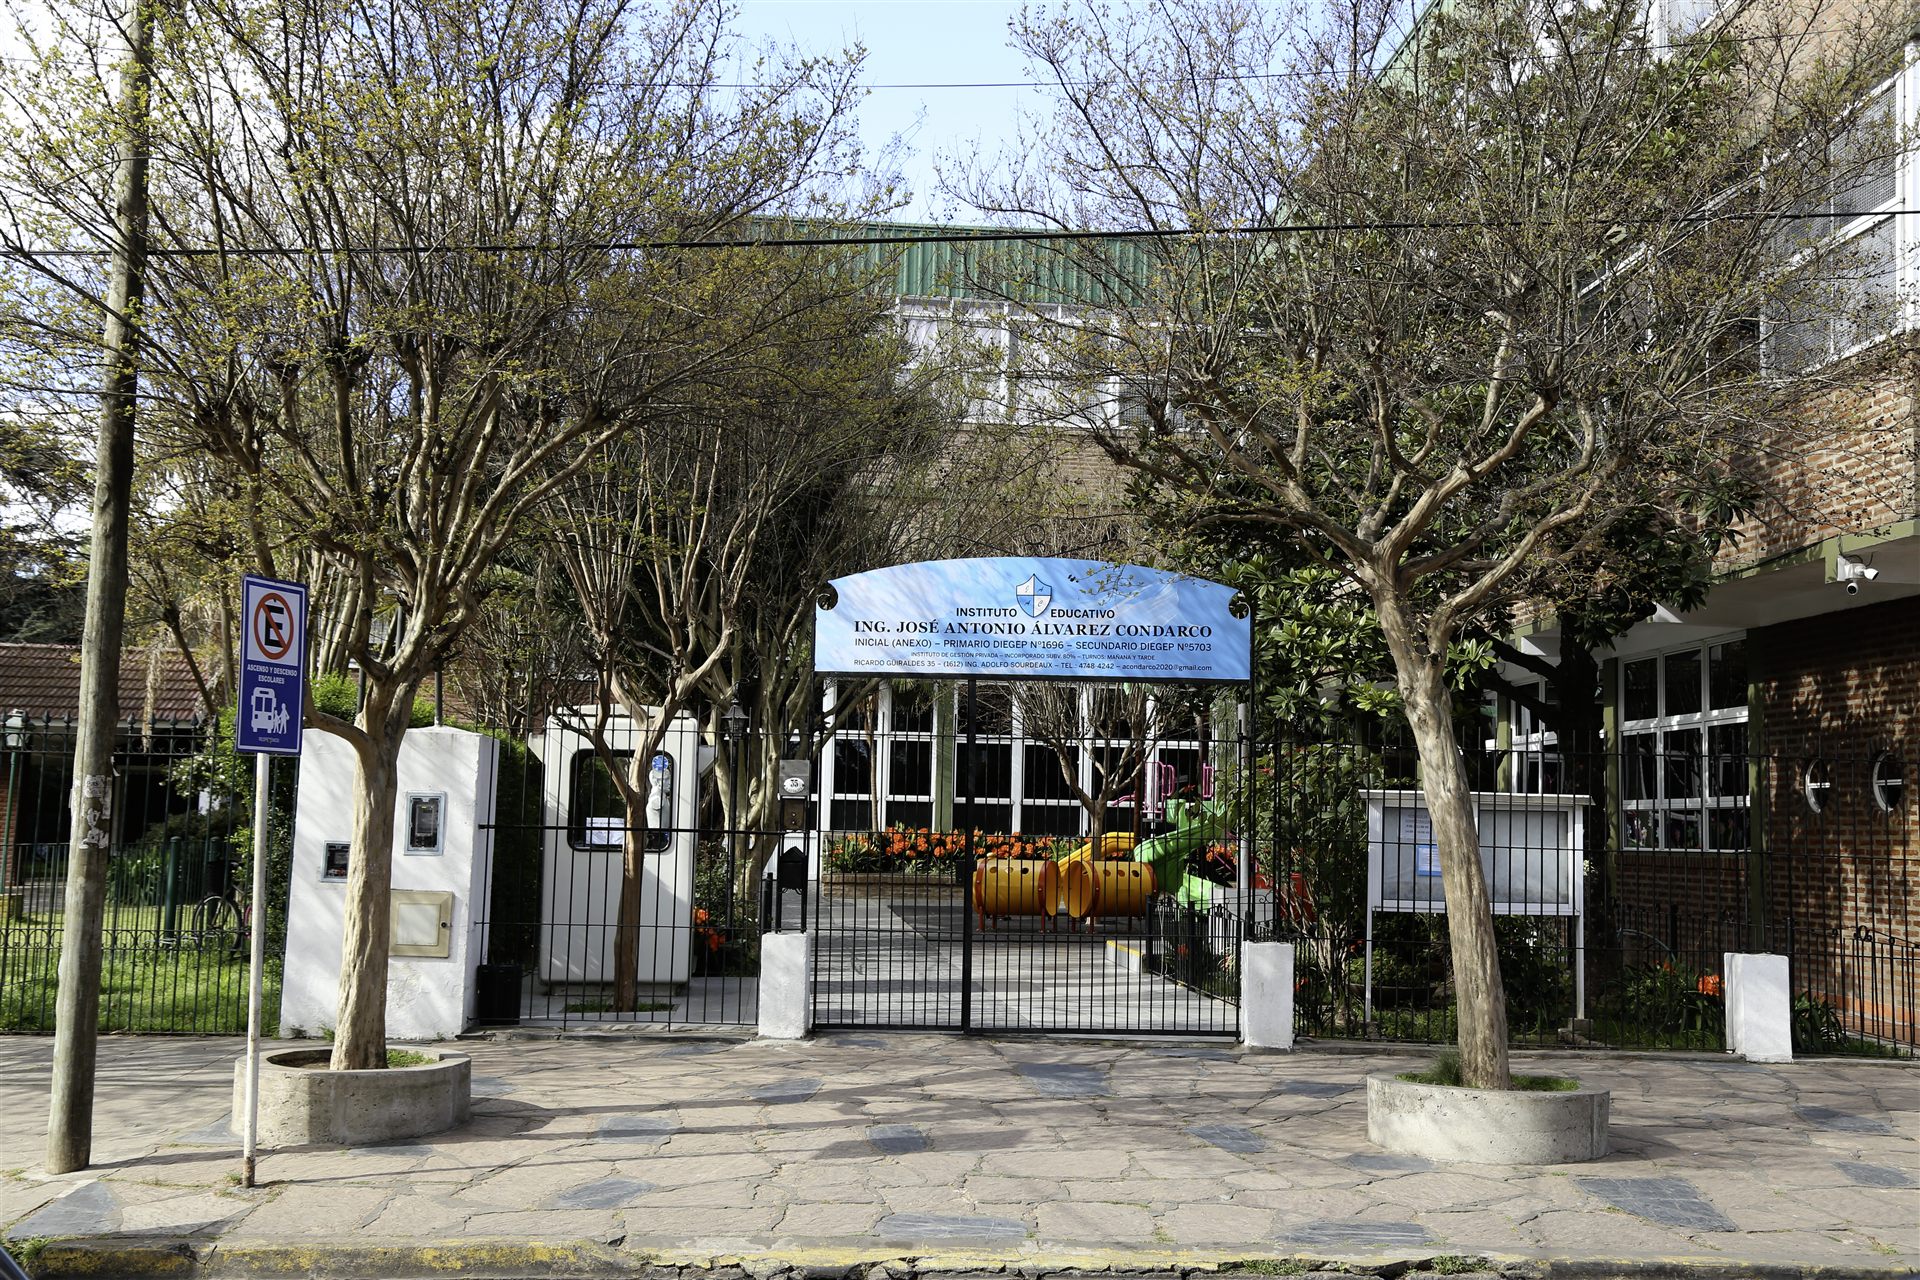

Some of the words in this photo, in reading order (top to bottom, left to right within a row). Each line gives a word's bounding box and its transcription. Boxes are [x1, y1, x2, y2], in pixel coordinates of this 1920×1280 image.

[956, 607, 1018, 618] INSTITUTO
[1050, 608, 1115, 619] EDUCATIVO
[264, 604, 285, 649] E
[854, 620, 891, 633] ING.
[896, 619, 939, 634] JOSÉ
[945, 622, 1026, 635] ANTONIO
[1031, 620, 1111, 637] ÁLVAREZ
[1115, 624, 1212, 638] CONDARCO
[855, 638, 889, 647] INICIAL
[891, 638, 932, 649] (ANEXO)
[943, 639, 990, 649] PRIMARIO
[993, 640, 1028, 649] DIEGEP
[1075, 641, 1137, 651] SECUNDARIO
[1140, 641, 1174, 651] DIEGEP
[1107, 653, 1132, 661] MAÑANA
[247, 663, 269, 673] ASCENSO
[273, 667, 298, 677] DESCENSO
[886, 658, 926, 667] GÜIRALDES
[943, 660, 964, 669] (1612)
[981, 661, 1009, 669] ADOLFO
[1010, 661, 1053, 669] SOURDEAUX
[1078, 662, 1115, 670] 4748-4242
[258, 674, 285, 685] ESCOLARES
